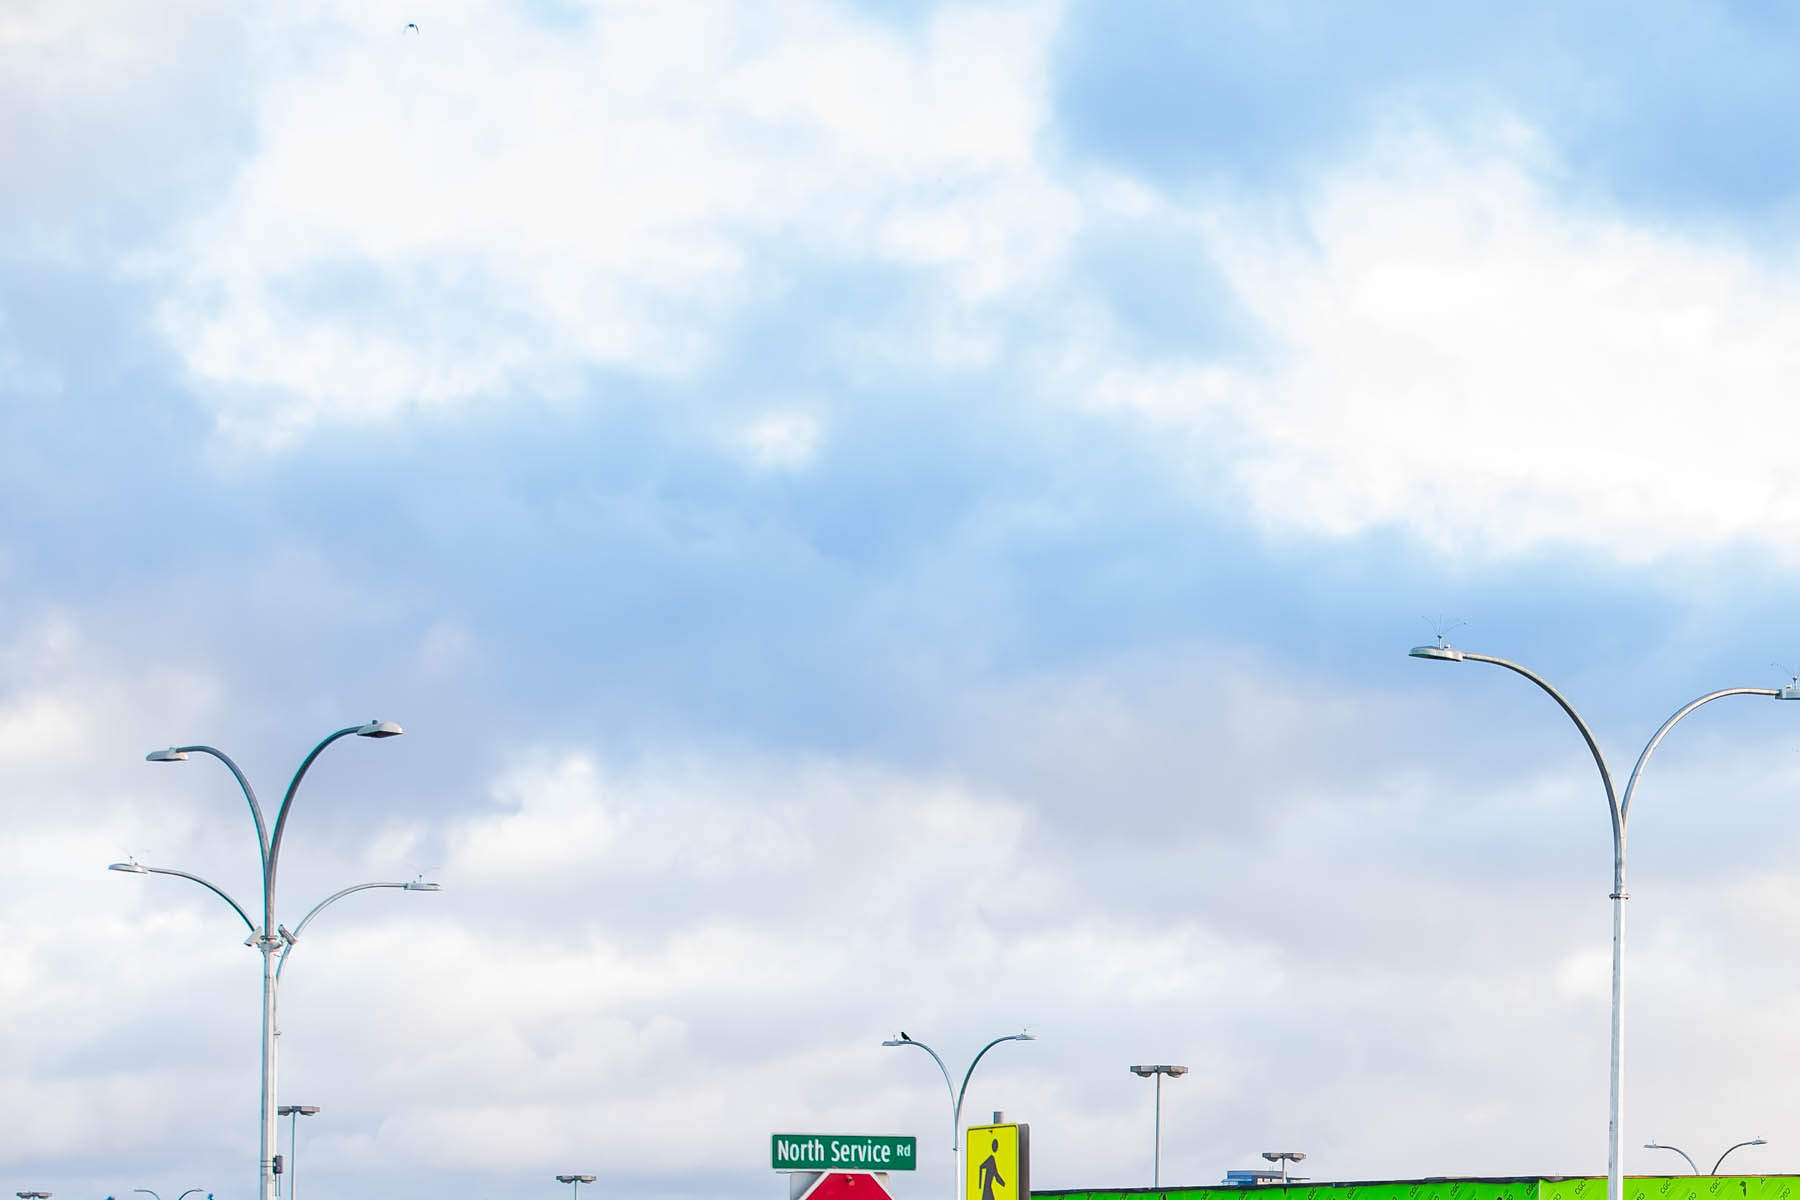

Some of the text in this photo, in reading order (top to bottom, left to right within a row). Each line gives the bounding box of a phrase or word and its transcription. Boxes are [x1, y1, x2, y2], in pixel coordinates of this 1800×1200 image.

[777, 1139, 911, 1163] North Service Rd
[1575, 1182, 1586, 1195] CGC
